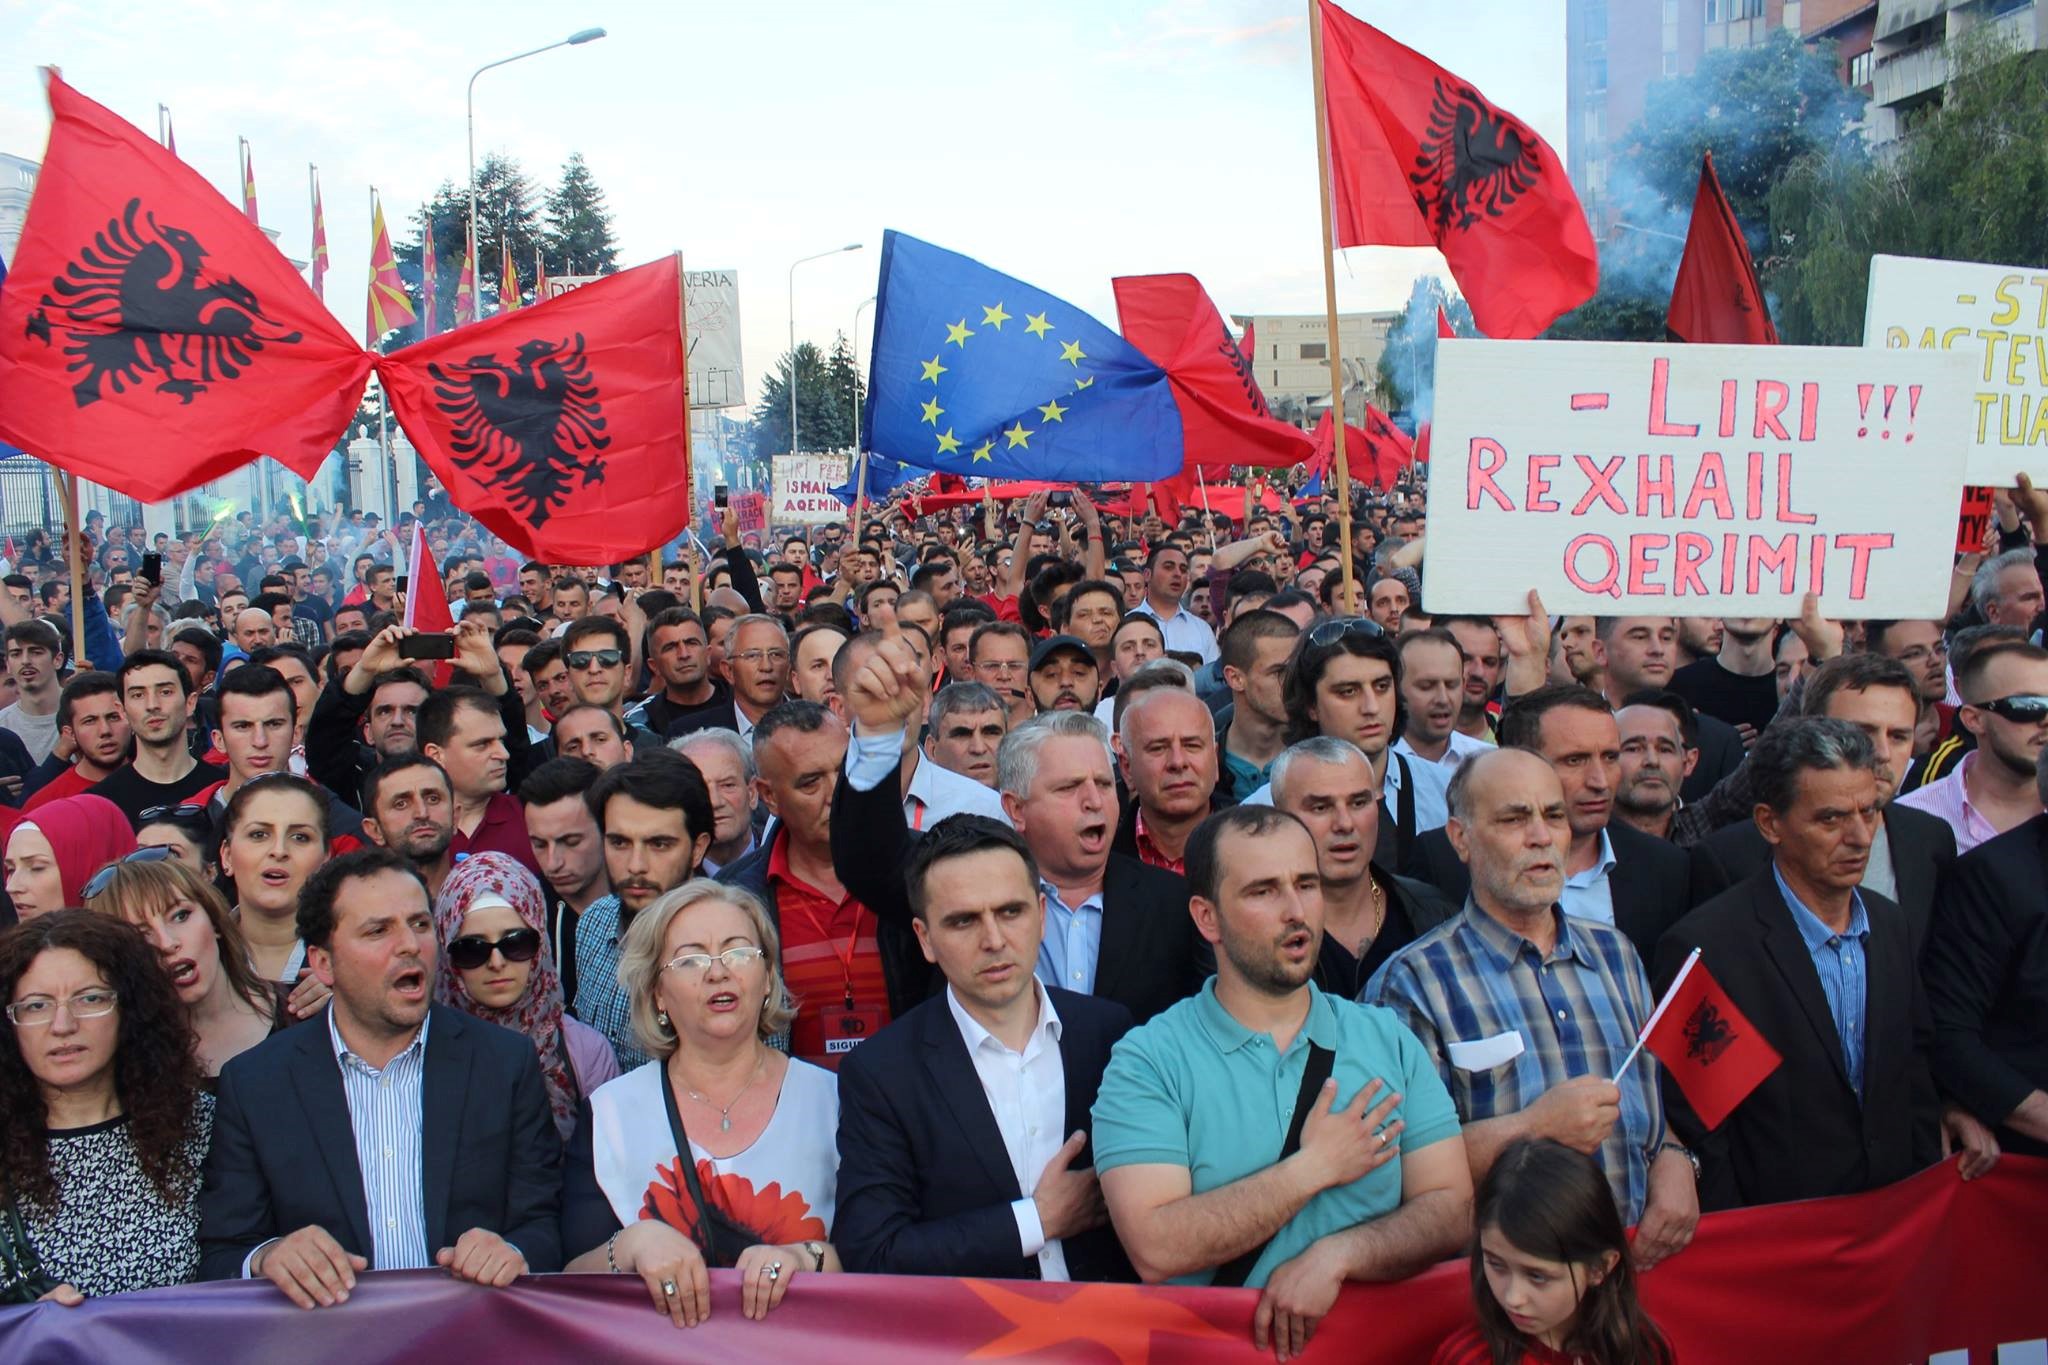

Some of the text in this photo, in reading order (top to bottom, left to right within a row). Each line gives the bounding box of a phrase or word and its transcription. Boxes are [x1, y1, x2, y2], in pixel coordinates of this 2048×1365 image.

[1648, 357, 1820, 442] LIRI
[782, 458, 808, 479] LIRI
[1466, 436, 1817, 525] REXHAIL
[783, 499, 841, 512] AQEMIN
[1562, 532, 1894, 600] QERIMIT
